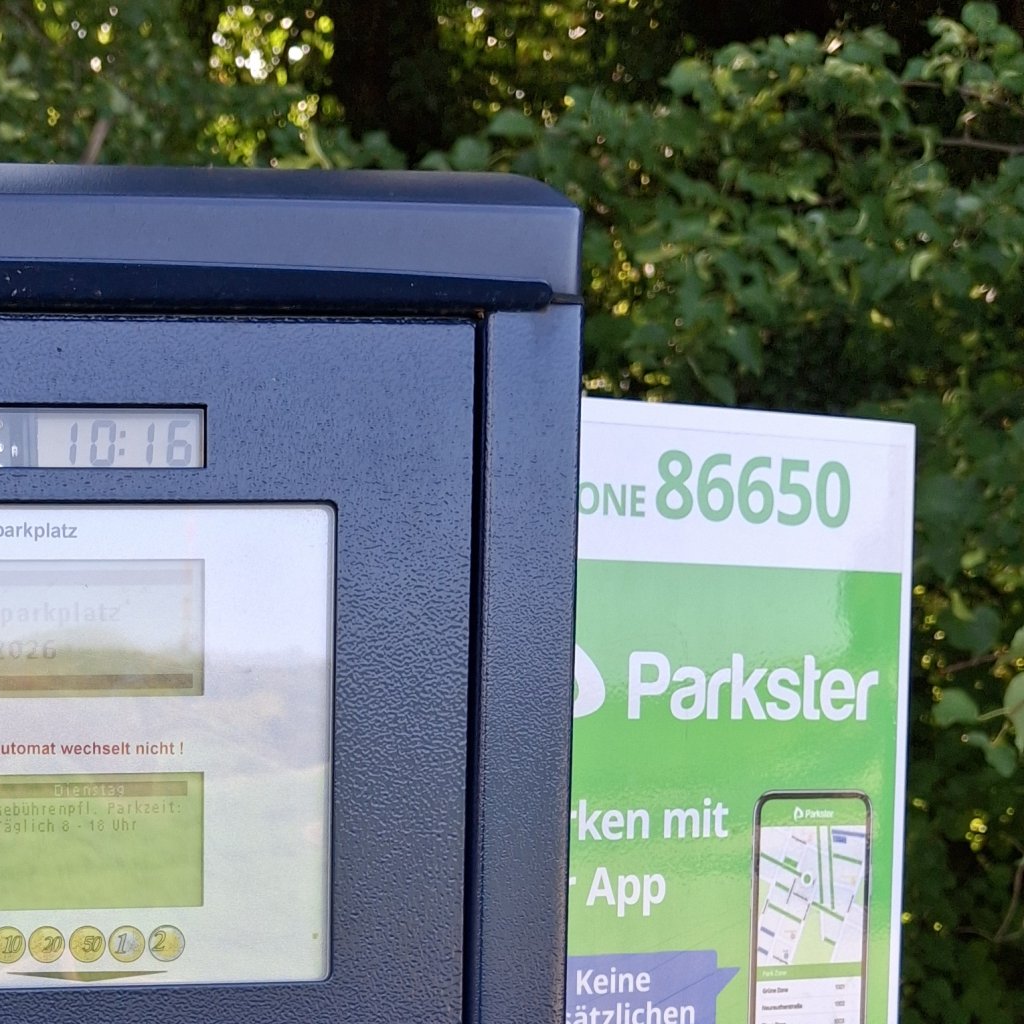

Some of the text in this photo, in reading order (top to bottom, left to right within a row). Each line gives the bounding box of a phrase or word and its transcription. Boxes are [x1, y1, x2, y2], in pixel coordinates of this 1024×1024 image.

[68, 419, 192, 466] 10:16
[579, 449, 851, 528] ONE 86650
[628, 651, 879, 721] Parkster
[61, 741, 131, 755] wechselt
[136, 742, 175, 755] nicht
[54, 783, 127, 797] Dienstag
[108, 799, 182, 815] Parkzeit:
[113, 819, 137, 831] Uhr
[664, 797, 729, 839] mit
[585, 866, 666, 918] App
[576, 967, 651, 995] Keine
